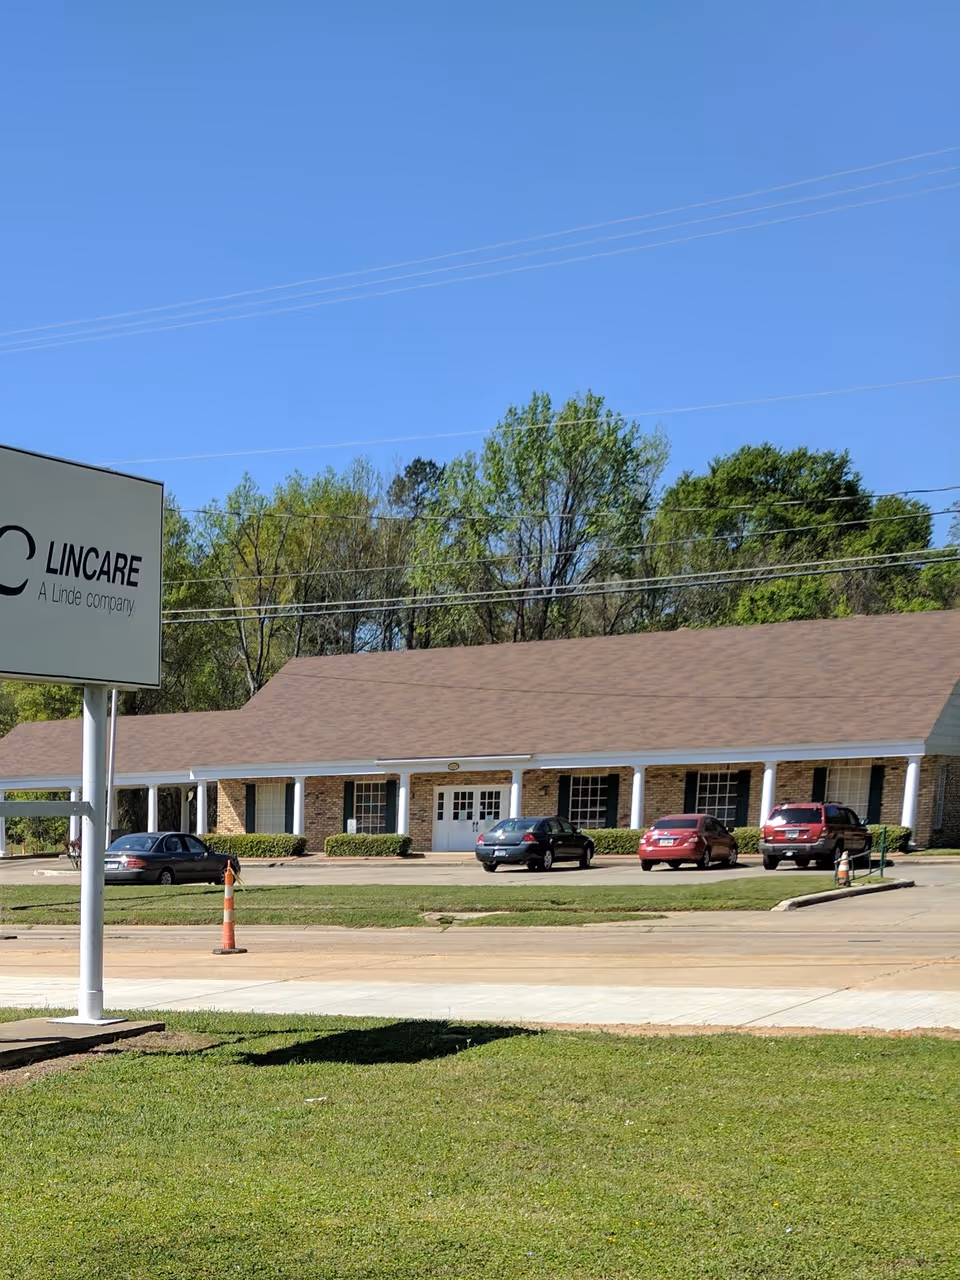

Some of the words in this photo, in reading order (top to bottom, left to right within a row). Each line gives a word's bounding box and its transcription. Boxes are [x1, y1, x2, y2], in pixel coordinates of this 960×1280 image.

[45, 541, 142, 588] LINCARE
[38, 581, 47, 601] A
[52, 583, 82, 606] Linde
[86, 592, 135, 617] company
